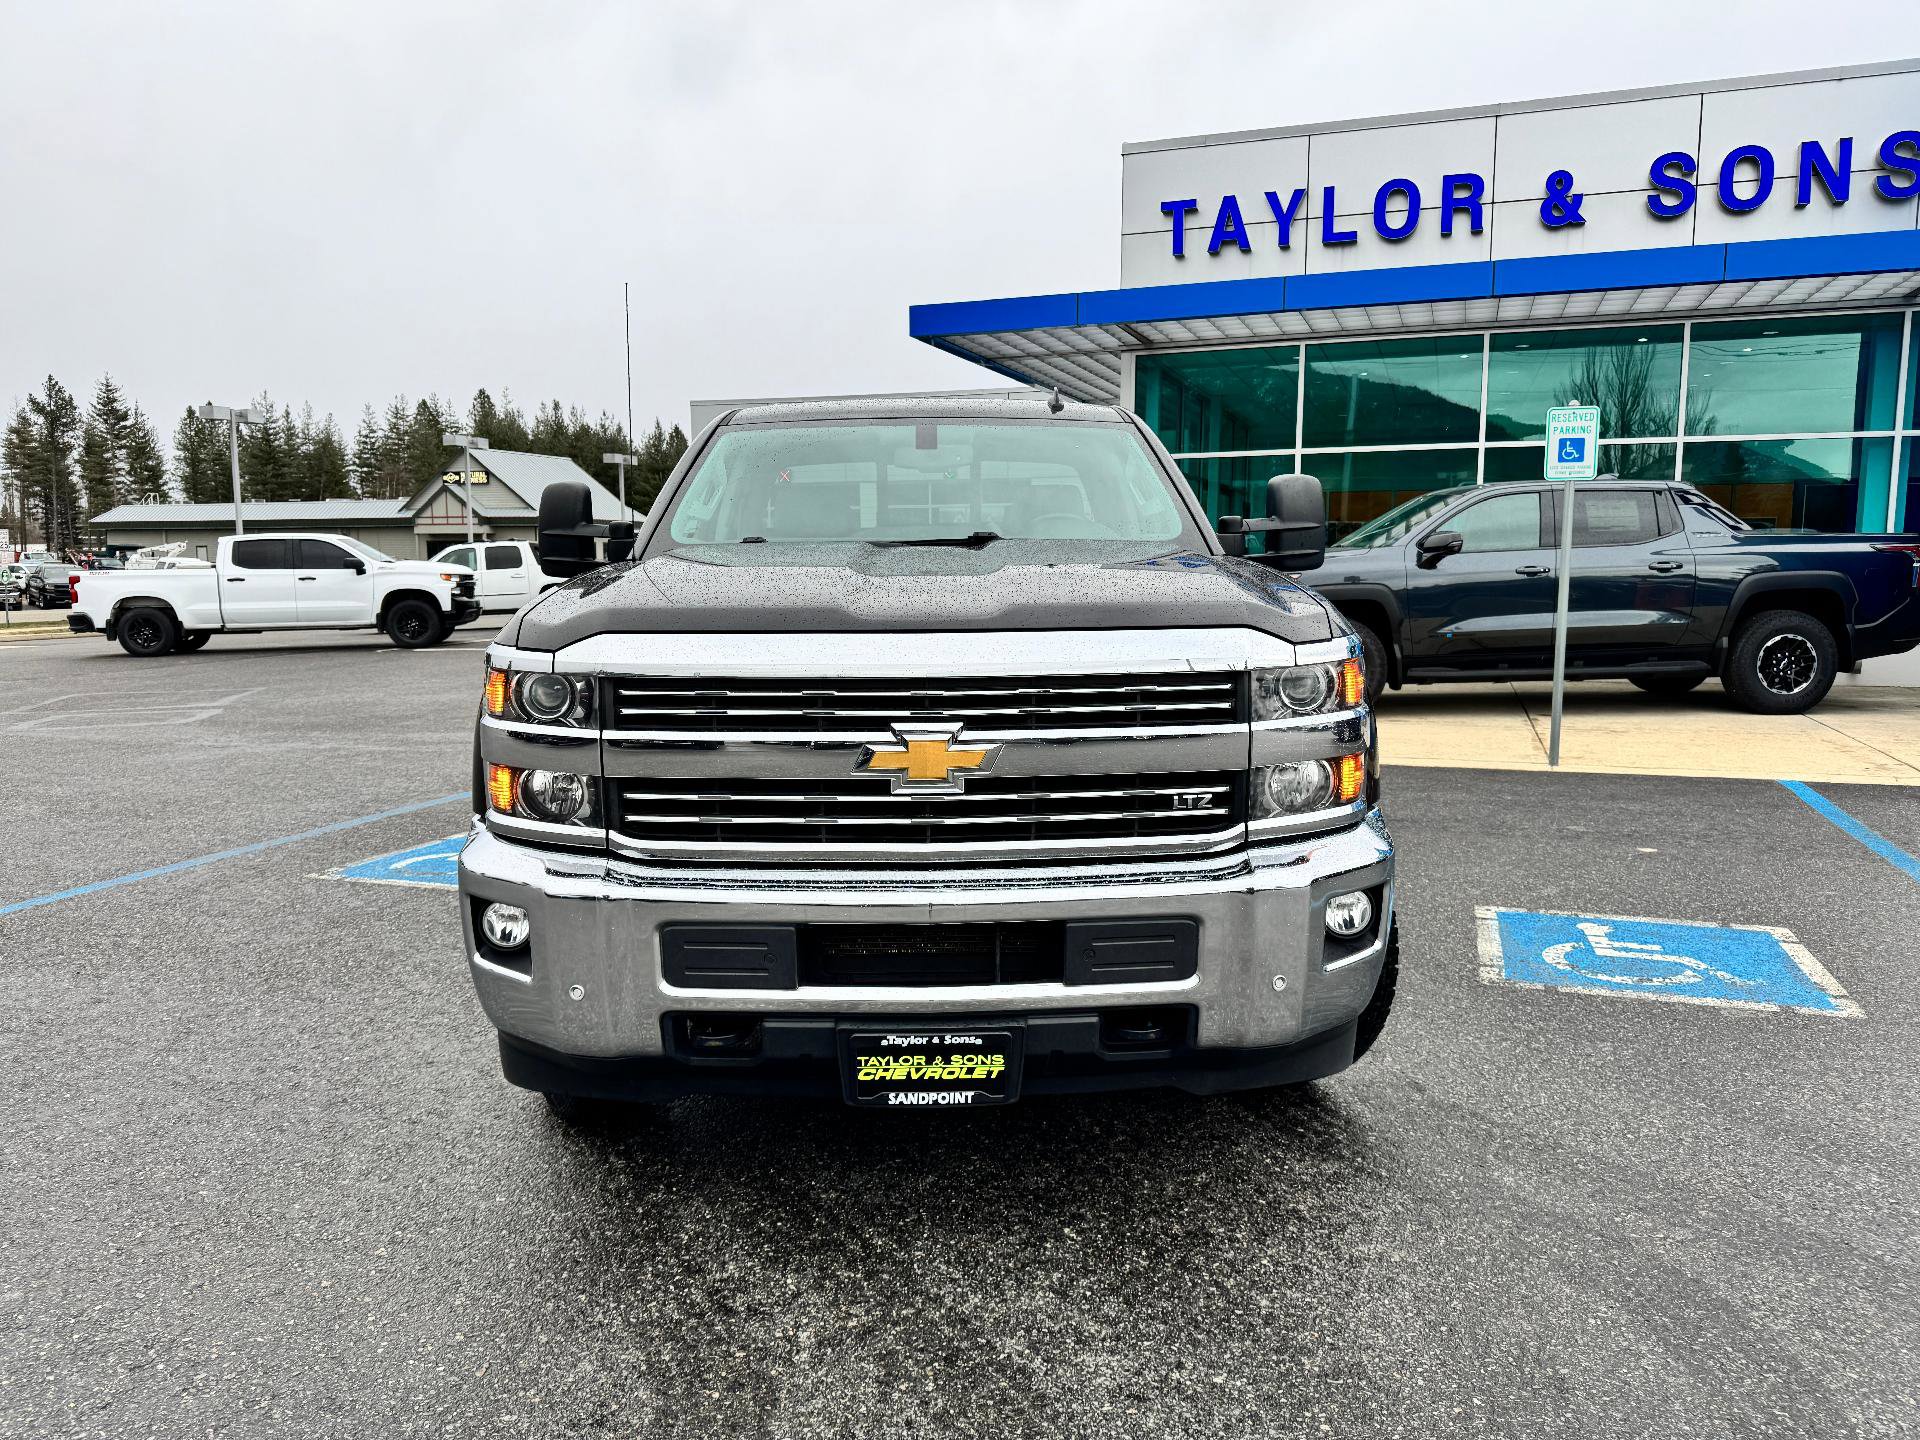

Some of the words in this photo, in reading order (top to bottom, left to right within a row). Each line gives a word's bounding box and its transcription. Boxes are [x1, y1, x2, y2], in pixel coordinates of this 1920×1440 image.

[1160, 173, 1485, 257] TAYLOR
[1540, 169, 1586, 228] &
[1647, 129, 1920, 218] SONS
[1551, 412, 1595, 423] RESERVED
[1553, 425, 1592, 435] PARKING
[1173, 794, 1213, 810] LTZ
[886, 1035, 929, 1047] Taylor
[931, 1036, 940, 1044] &
[943, 1034, 976, 1045] Sons
[857, 1055, 926, 1067] TAYLOR
[932, 1055, 945, 1067] &
[950, 1054, 1005, 1066] SONS
[857, 1066, 1005, 1081] CHEVROLET
[887, 1092, 975, 1105] SANDPOINT
